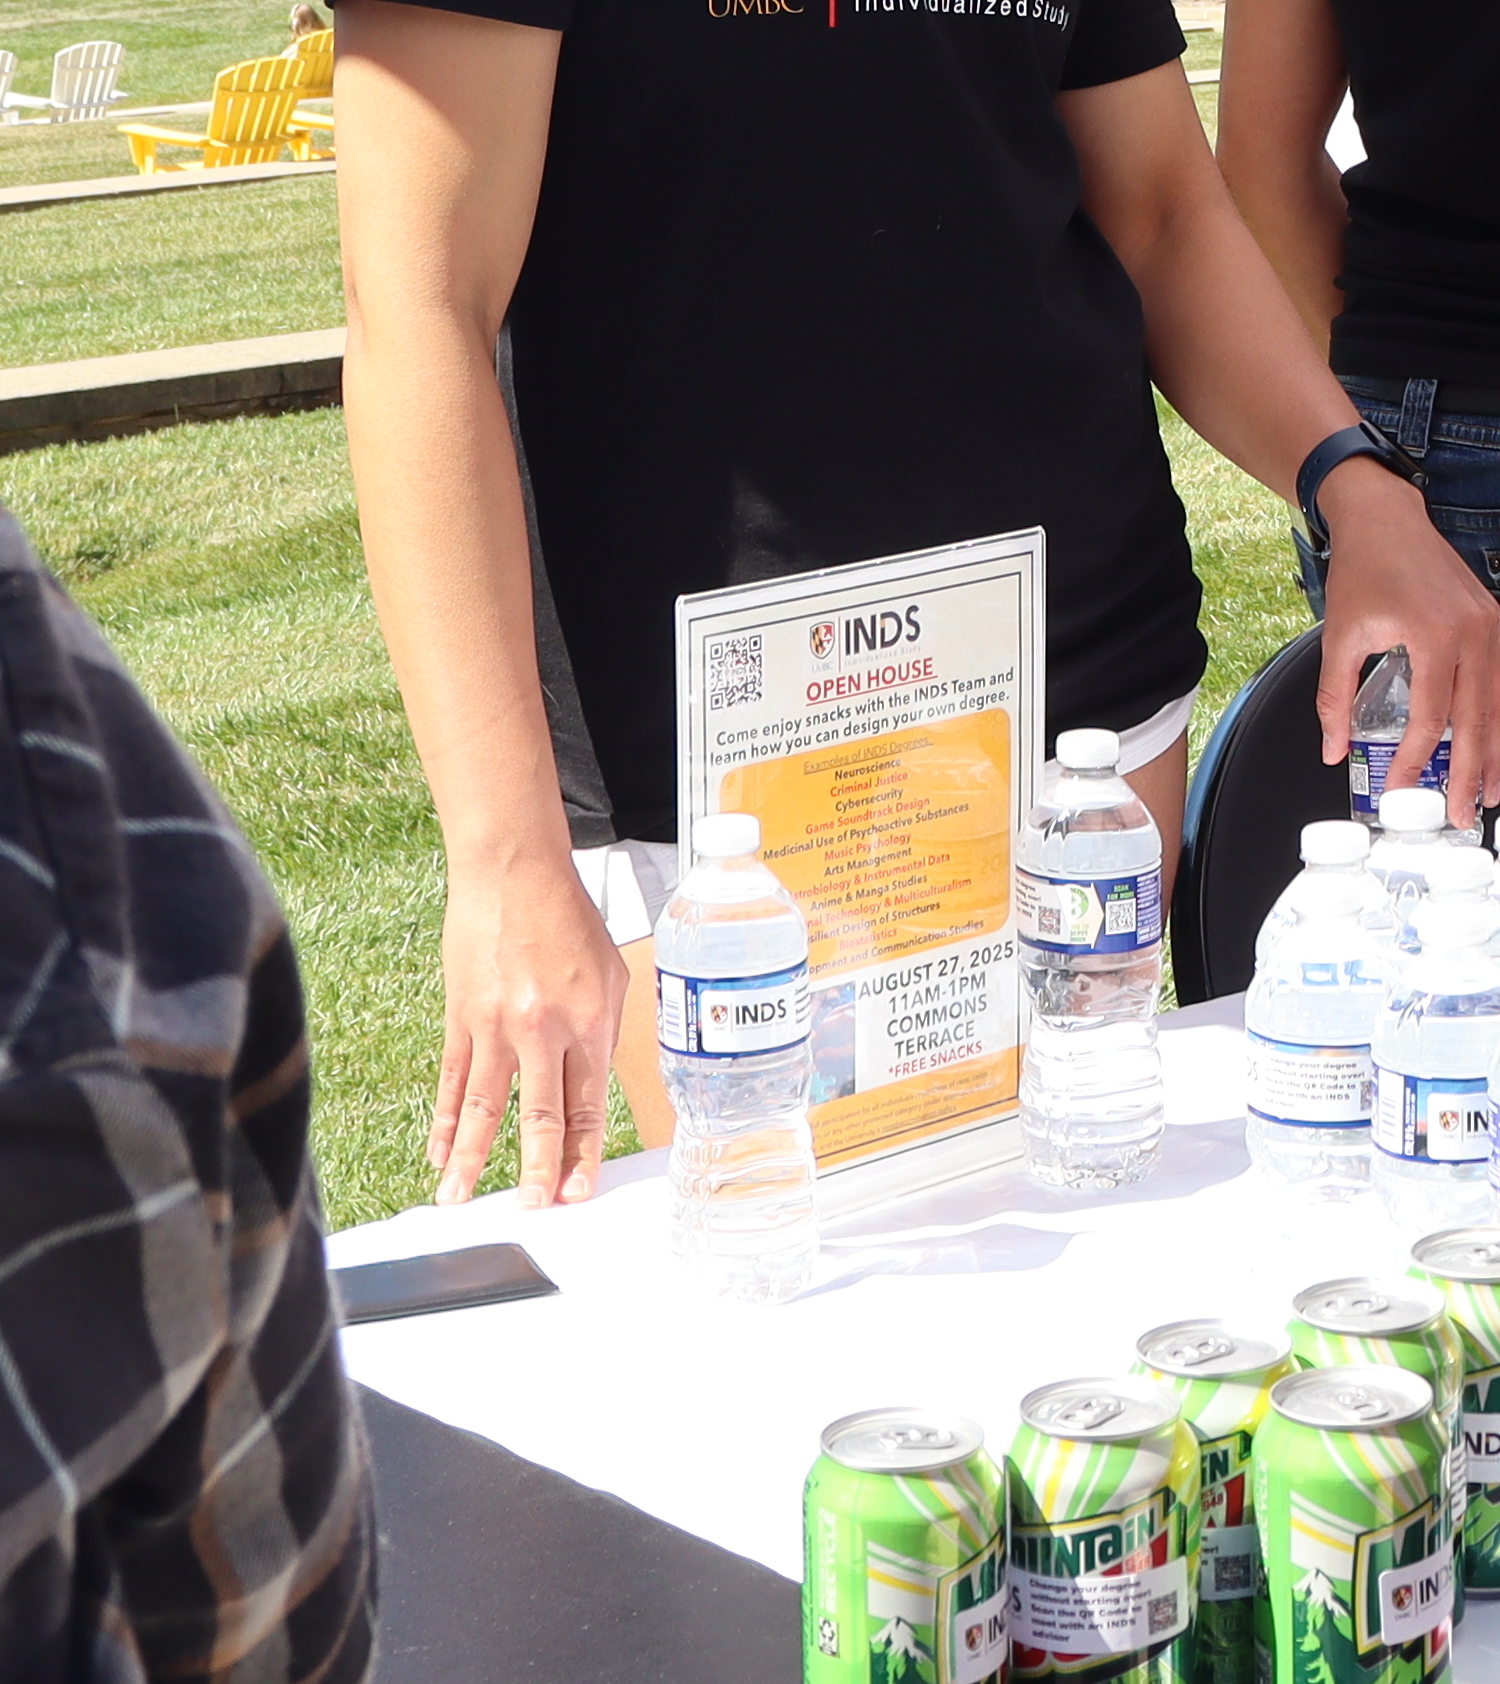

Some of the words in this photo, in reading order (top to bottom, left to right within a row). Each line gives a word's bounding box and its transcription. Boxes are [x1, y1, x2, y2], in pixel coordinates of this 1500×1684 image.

[844, 604, 921, 657] INDS
[806, 672, 861, 702] OPEN
[867, 657, 933, 690] HOUSE
[716, 729, 758, 747] Come
[762, 718, 801, 739] enjoy
[805, 705, 851, 728] snacks
[855, 695, 886, 716] with
[888, 690, 911, 707] the
[913, 681, 948, 703] INDS
[951, 676, 986, 695] Team
[989, 667, 1015, 687] and
[710, 744, 747, 767] learn
[750, 740, 782, 758] how
[785, 734, 812, 759] you
[815, 728, 839, 744] can
[843, 716, 890, 738] design
[892, 709, 924, 733] your
[927, 702, 956, 718] own
[959, 690, 1011, 712] degree.
[804, 752, 850, 772] Examples
[851, 748, 862, 762] of
[863, 744, 888, 758] INDS
[835, 758, 901, 781] Neuroscience
[830, 778, 872, 798] Criminal
[874, 771, 909, 788] Justice
[835, 788, 904, 813] Cybersecurity
[763, 838, 815, 861] Medicinal
[816, 834, 835, 850] Use
[836, 831, 848, 844] of
[850, 815, 913, 841] Psychoactive
[915, 802, 969, 824] Substances
[805, 819, 835, 835] Game
[837, 806, 893, 828] Soundtrack
[895, 796, 930, 814] Design
[824, 846, 855, 862] Music
[856, 832, 912, 854] Psychology
[824, 863, 845, 877] Arts
[847, 847, 913, 873] Management
[853, 874, 862, 886] &
[864, 858, 927, 884] Instrumental
[928, 852, 951, 867] Data
[810, 894, 843, 912] Anime
[845, 891, 853, 903] &
[855, 884, 890, 902] Manga
[891, 873, 928, 891] Studies
[825, 902, 883, 925] Technology
[884, 897, 893, 909] &
[894, 878, 972, 906] Multiculturalism
[842, 917, 878, 936] Design
[879, 913, 890, 926] of
[891, 901, 941, 923] Structures
[808, 957, 848, 976] opment
[850, 950, 869, 964] and
[870, 929, 947, 958] Communication
[948, 919, 985, 937] Studies
[839, 927, 898, 951] Biostatistics
[858, 963, 934, 1000] AUGUST
[937, 955, 965, 978] 27,
[969, 940, 1015, 968] 2025
[888, 971, 987, 1015] 11AM-1PM
[734, 998, 787, 1025] INDS
[886, 994, 988, 1038] COMMONS
[894, 1019, 976, 1059] TERRACE
[930, 1040, 984, 1068] SNACKS
[1323, 1062, 1358, 1071] degree
[1303, 1082, 1317, 1091] QR
[1319, 1082, 1345, 1090] Code
[1346, 1082, 1357, 1090] to
[1325, 1092, 1351, 1101] INDS
[1466, 1109, 1489, 1133] IN
[825, 1513, 838, 1614] RECYCLE
[1070, 1586, 1098, 1595] your
[1101, 1580, 1141, 1593] degree
[1419, 1562, 1452, 1605] IND
[1058, 1621, 1085, 1631] with
[1107, 1618, 1137, 1629] INDS
